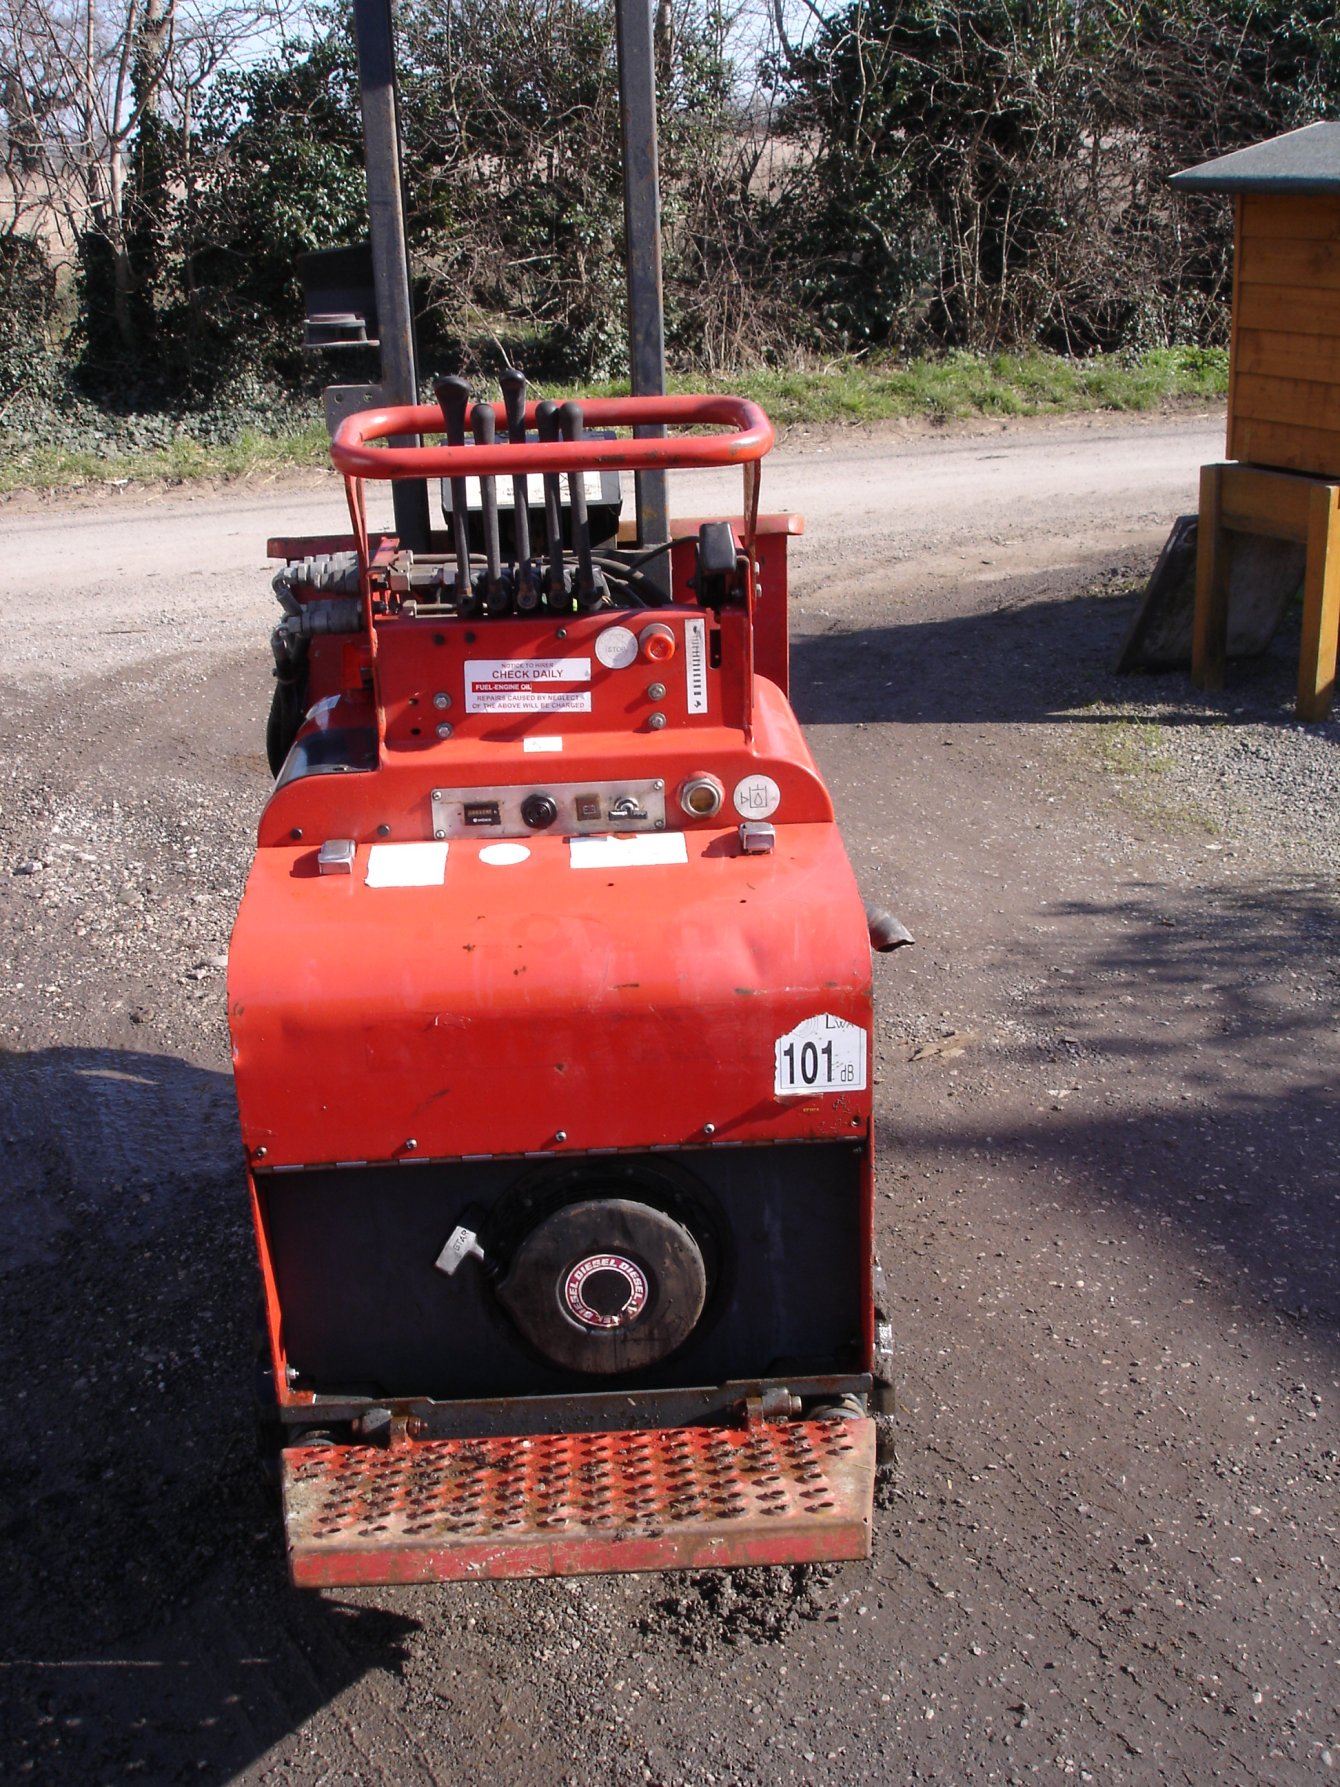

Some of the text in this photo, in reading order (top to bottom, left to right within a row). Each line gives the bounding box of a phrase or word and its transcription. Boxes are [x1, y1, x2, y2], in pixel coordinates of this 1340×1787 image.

[492, 669, 563, 679] CHECK DAILY
[783, 1040, 854, 1084] 101 dB
[573, 1258, 618, 1281] DIESEL
[619, 1262, 643, 1300] DIESEL
[569, 1281, 594, 1319] DIESEL
